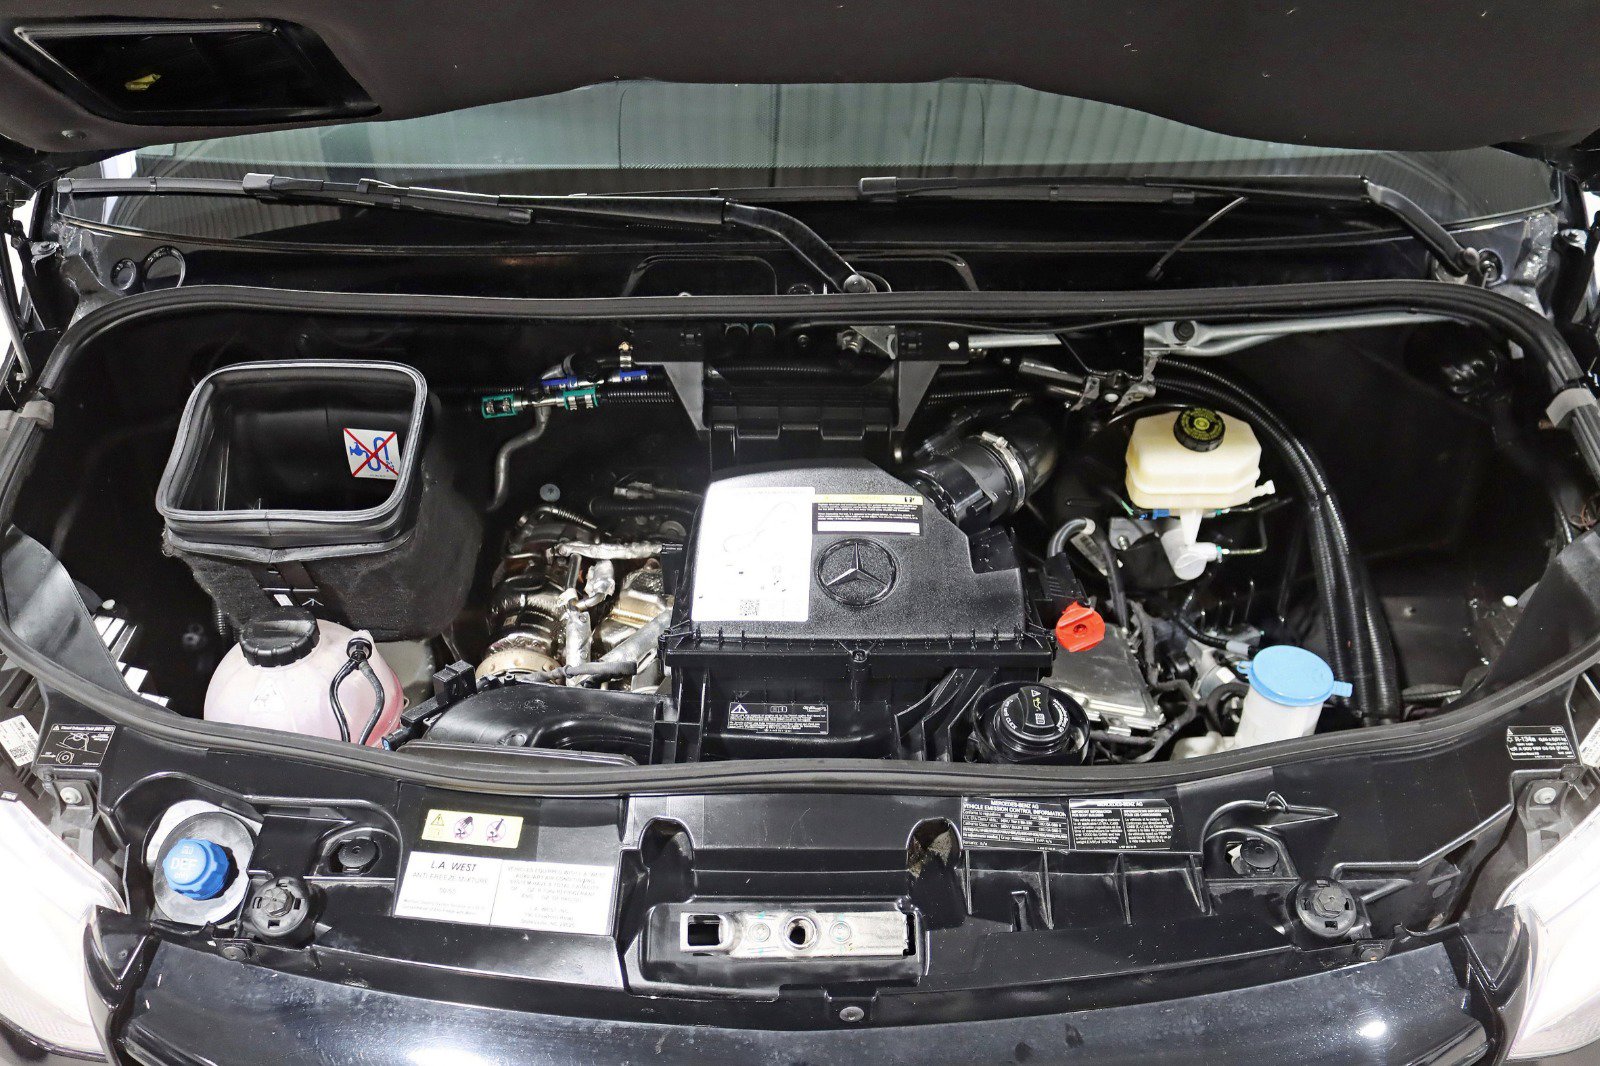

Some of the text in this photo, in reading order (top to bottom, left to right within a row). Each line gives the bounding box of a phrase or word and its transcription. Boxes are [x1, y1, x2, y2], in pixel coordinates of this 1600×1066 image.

[1006, 717, 1017, 730] CLICK
[1033, 809, 1067, 817] INFORMATION
[170, 857, 198, 870] DEF
[451, 862, 477, 872] WEST
